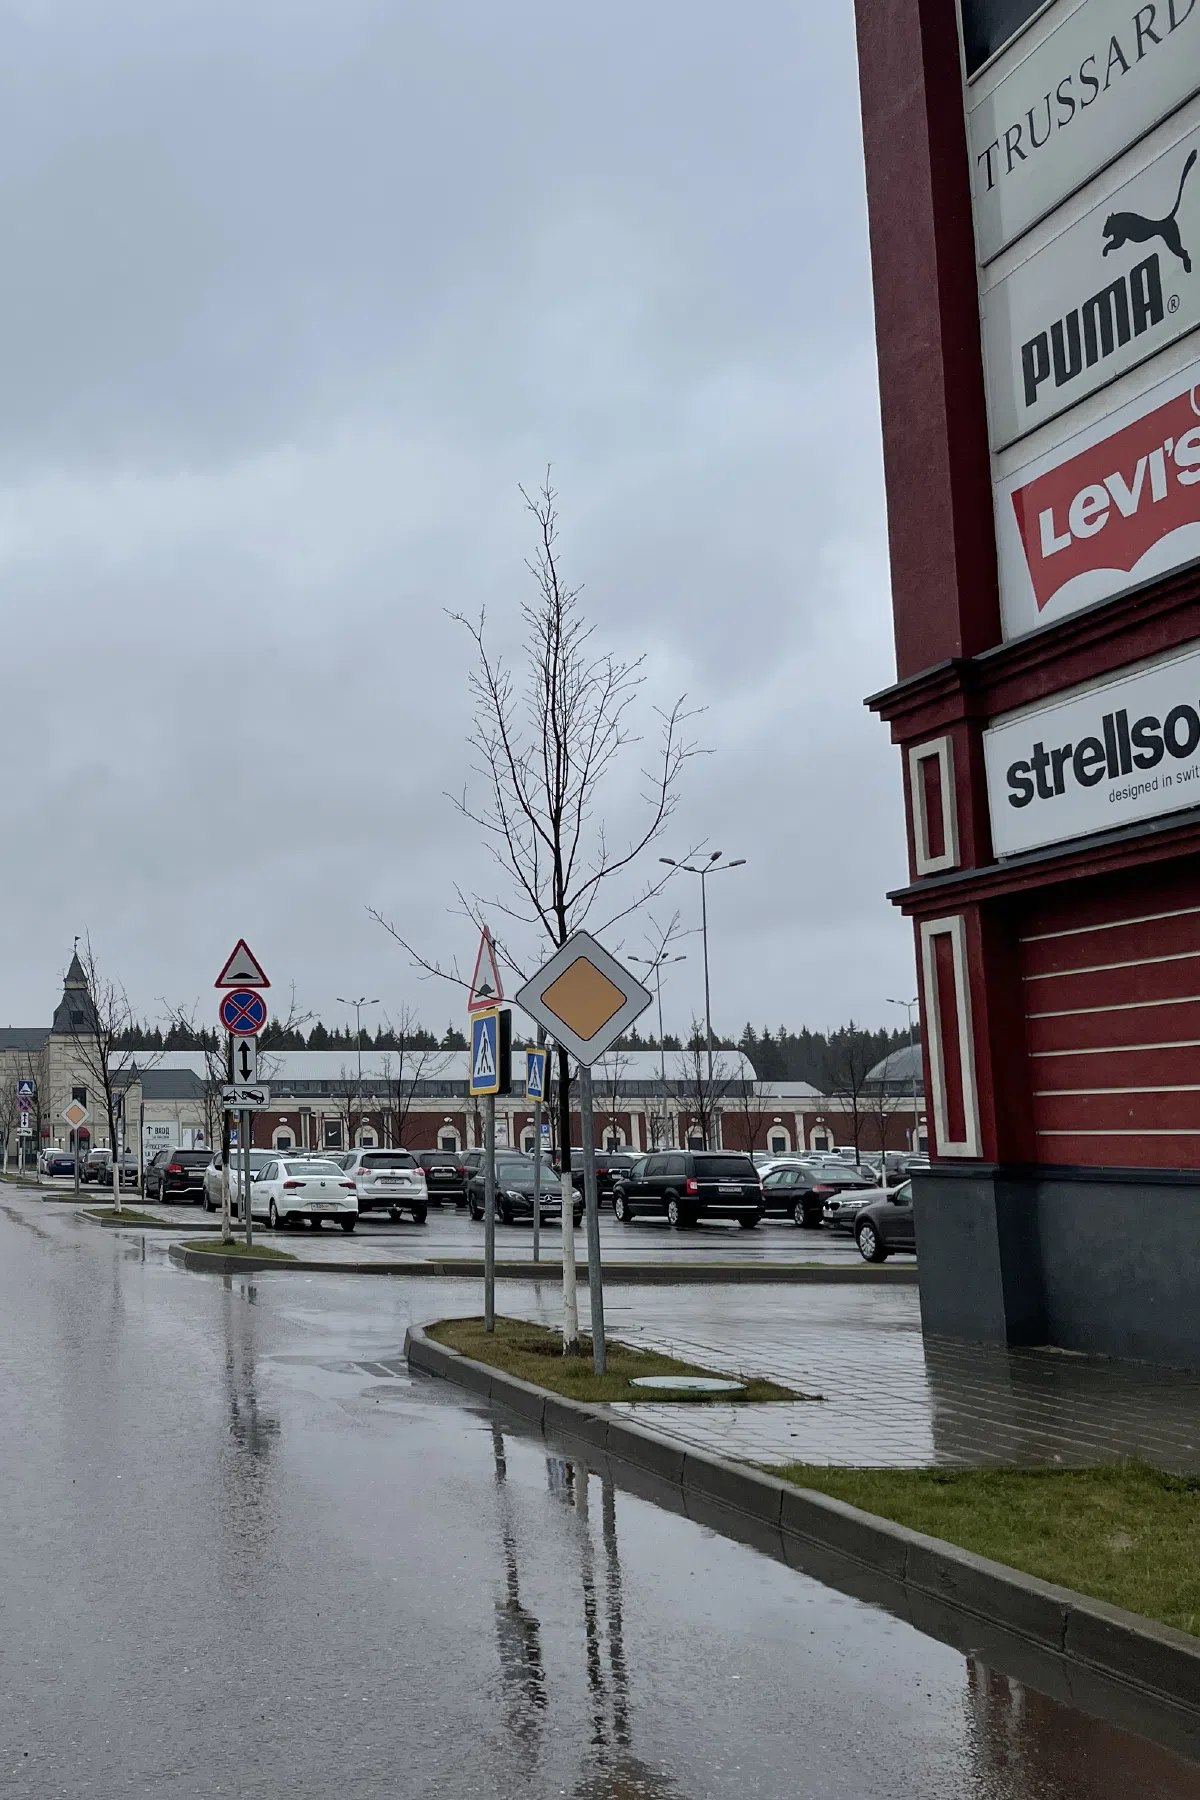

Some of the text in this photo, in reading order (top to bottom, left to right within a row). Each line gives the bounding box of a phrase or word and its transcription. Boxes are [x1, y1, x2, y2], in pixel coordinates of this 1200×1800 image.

[1021, 252, 1165, 408] PUMA
[1006, 700, 1200, 809] strellso
[1108, 764, 1200, 803] designed in swit
